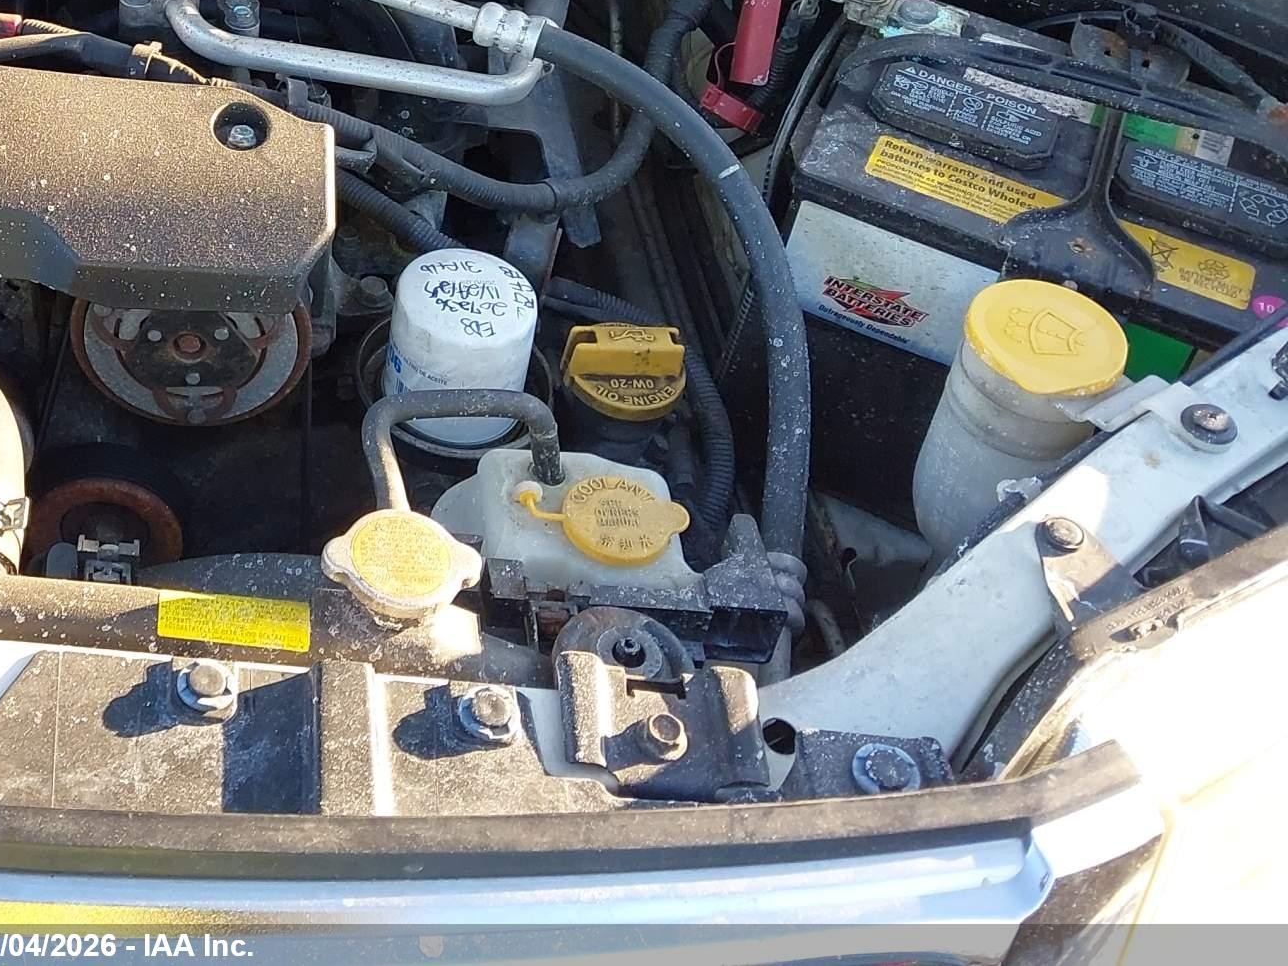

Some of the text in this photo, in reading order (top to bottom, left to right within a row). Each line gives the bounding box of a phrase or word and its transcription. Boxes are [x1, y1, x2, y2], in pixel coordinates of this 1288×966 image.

[917, 69, 973, 94] DANGER
[986, 92, 1037, 115] POISON
[879, 149, 932, 173] batteries
[933, 166, 945, 179] to
[948, 174, 986, 194] Costco
[884, 140, 1037, 200] Return warranty and used
[822, 286, 914, 327] BATTERIES
[824, 275, 926, 321] INTERSTATE
[596, 385, 676, 406] ENGINE OIL
[610, 378, 654, 389] 0W-20
[571, 475, 657, 504] COOLANT
